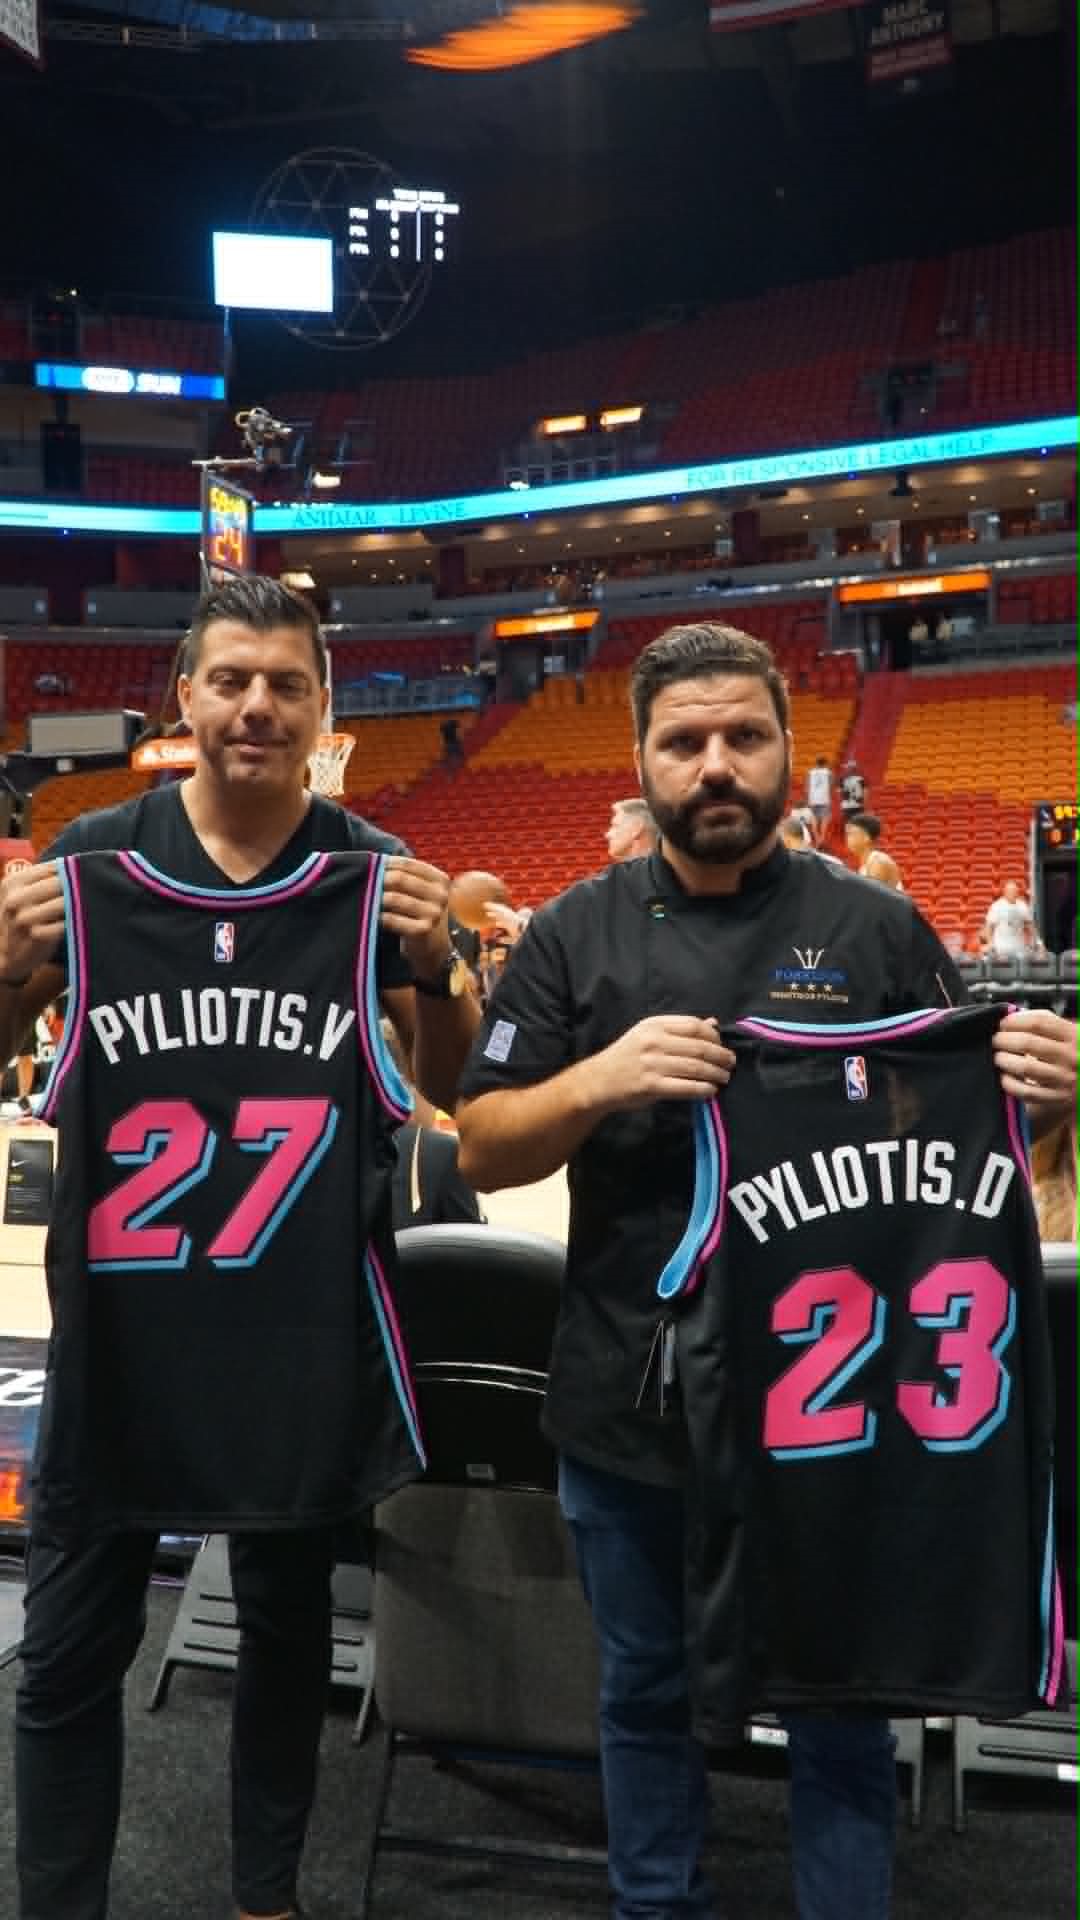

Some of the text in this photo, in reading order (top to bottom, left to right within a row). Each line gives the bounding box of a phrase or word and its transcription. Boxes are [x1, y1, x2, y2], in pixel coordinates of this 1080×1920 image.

[88, 986, 355, 1065] PYLIOTIS.V
[87, 1098, 338, 1272] 27
[728, 1138, 1015, 1243] PYLIOTIS.D
[763, 1256, 1017, 1460] 23
